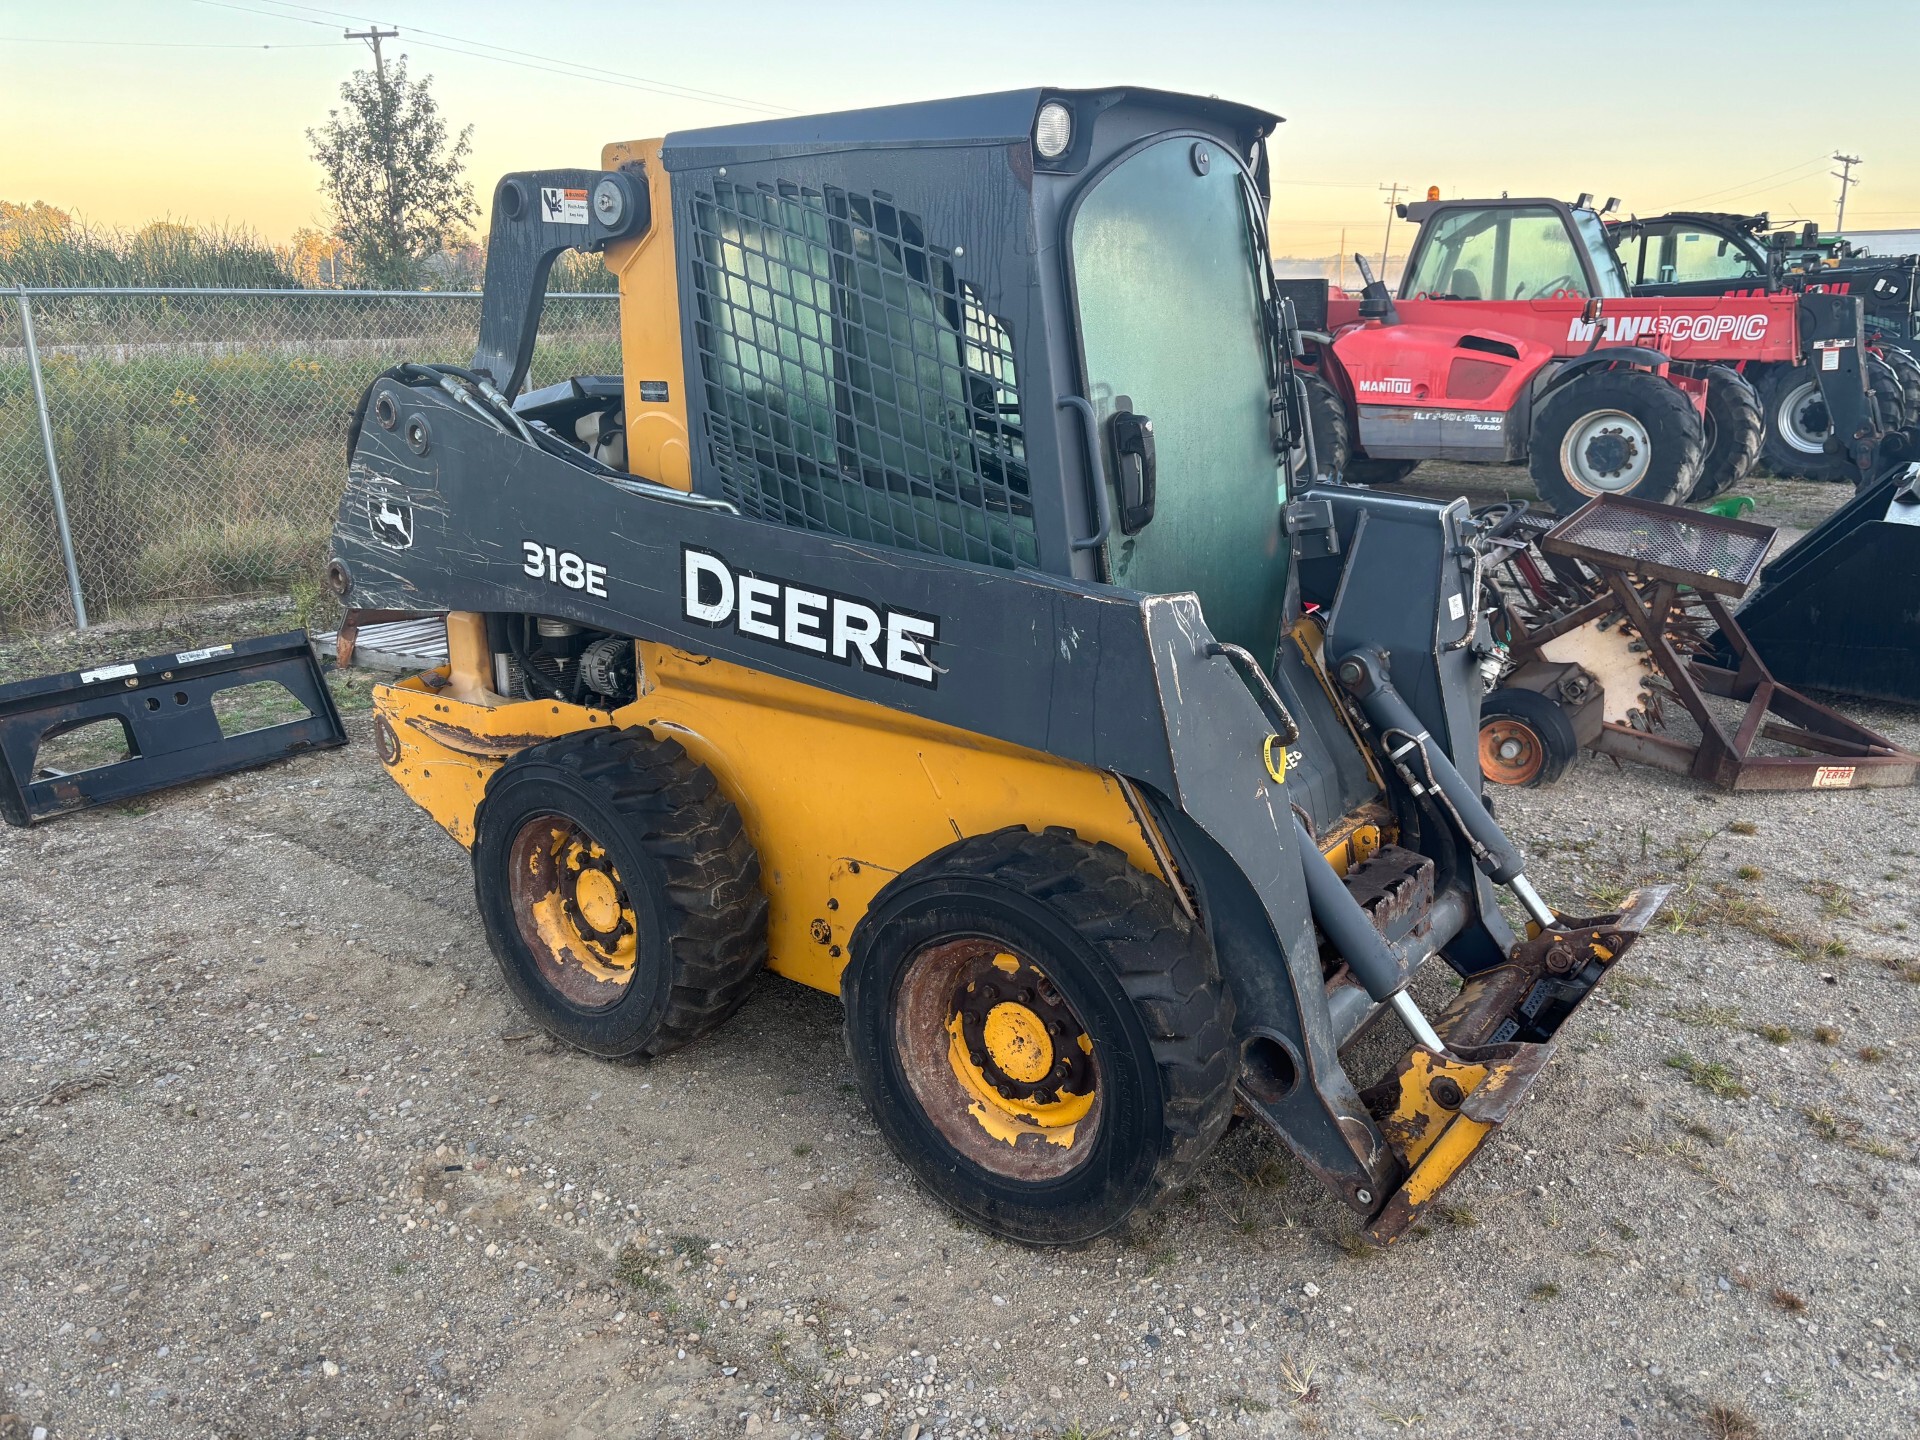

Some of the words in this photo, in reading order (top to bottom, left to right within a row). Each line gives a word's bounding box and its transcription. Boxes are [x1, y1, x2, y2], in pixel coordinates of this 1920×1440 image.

[1567, 314, 1768, 342] MANISCOPIC
[1359, 377, 1412, 394] MANITOU
[523, 541, 608, 598] 318E
[685, 549, 935, 682] DEERE
